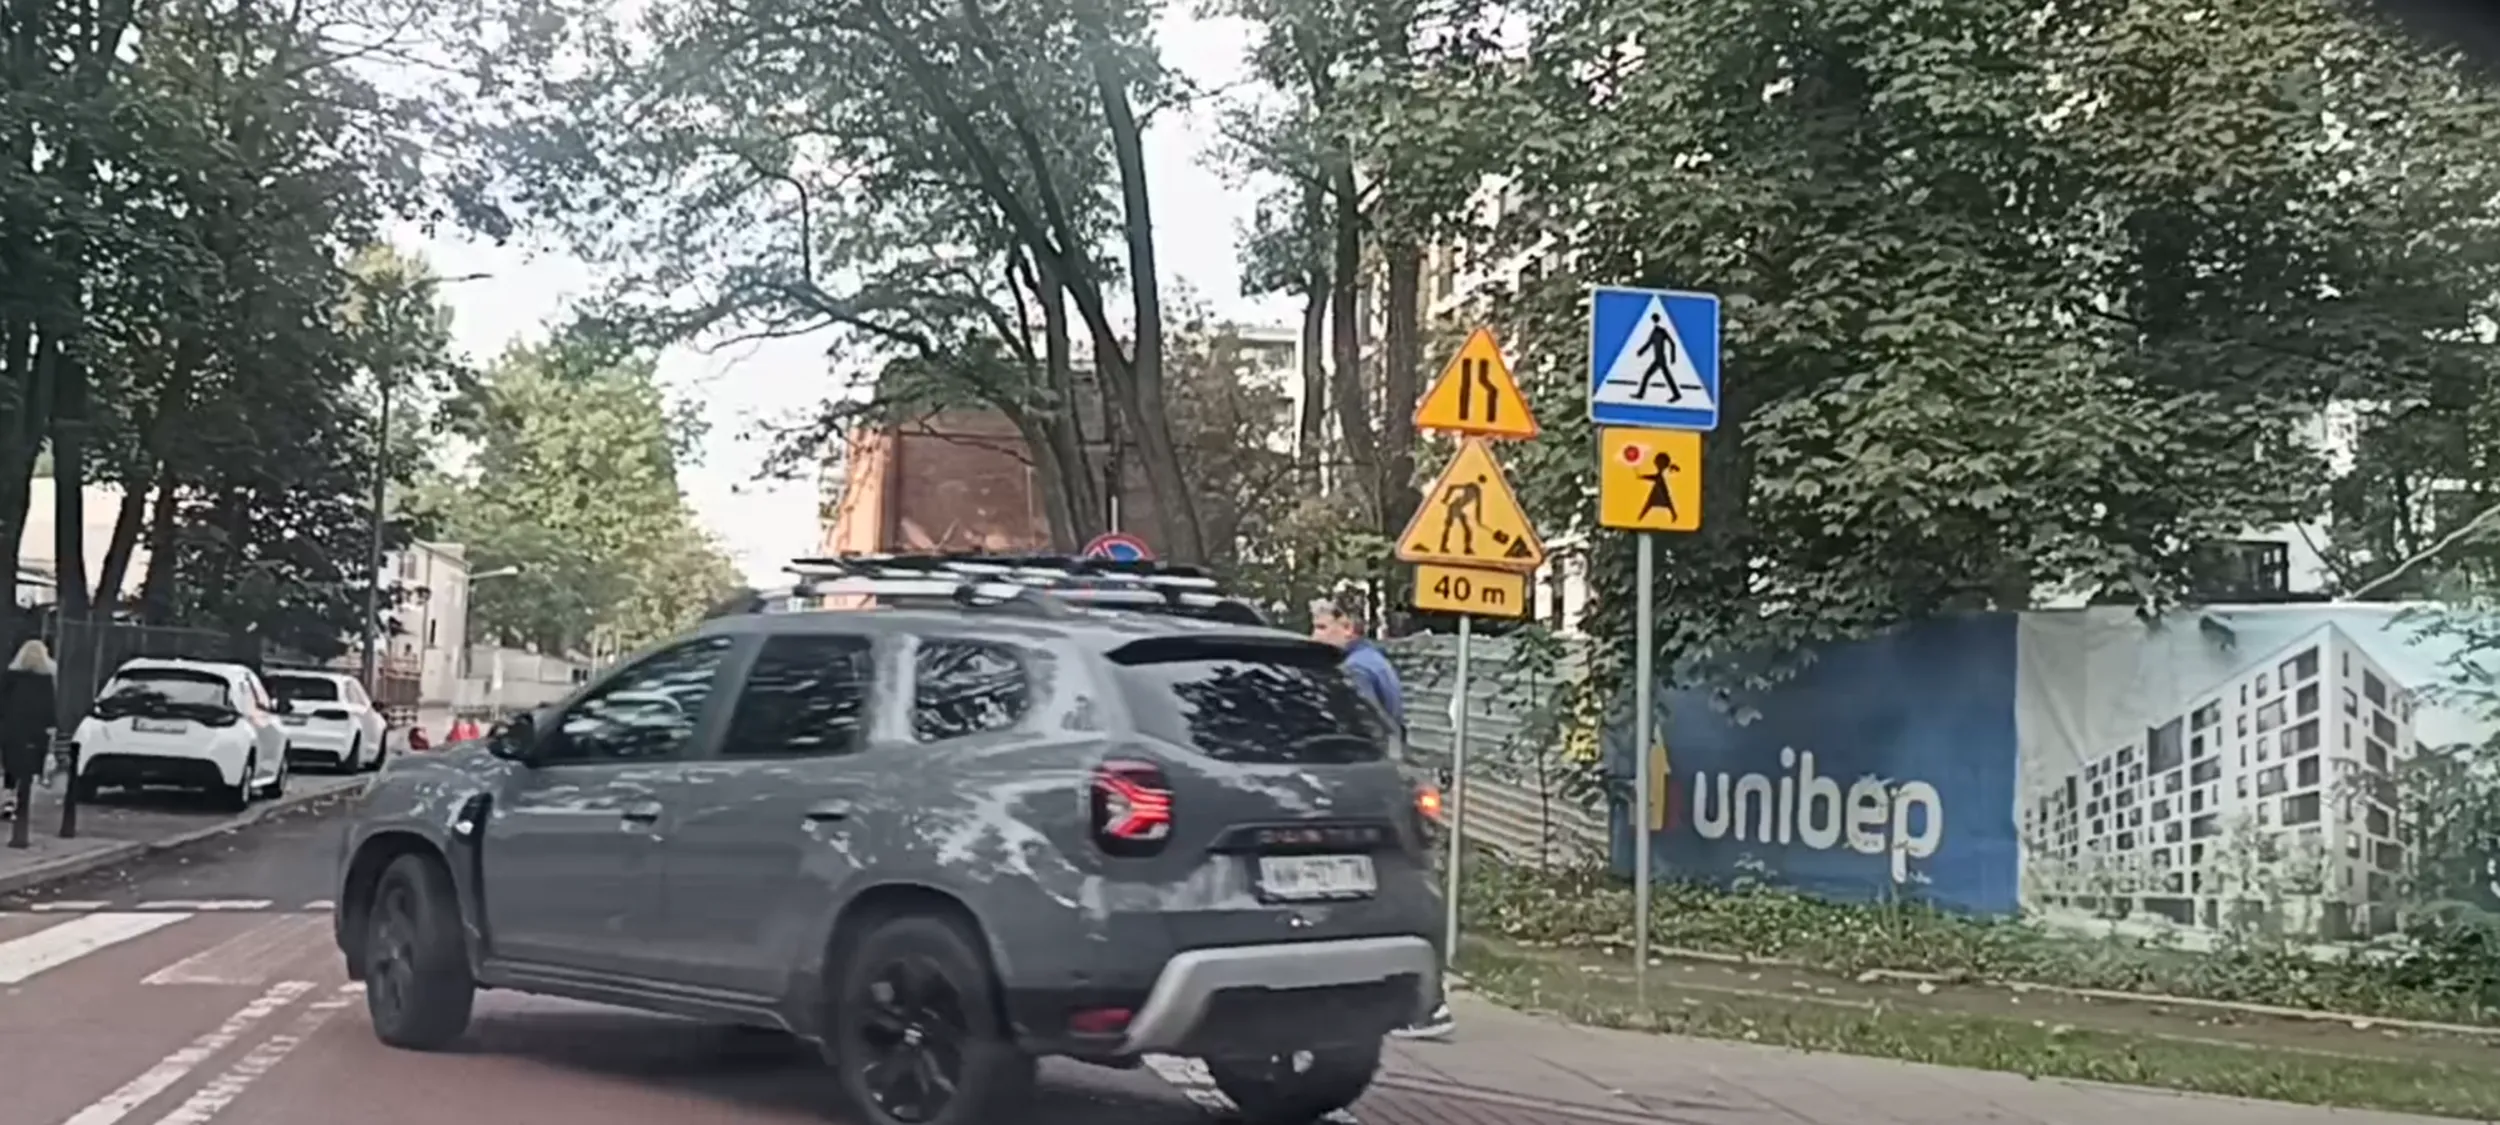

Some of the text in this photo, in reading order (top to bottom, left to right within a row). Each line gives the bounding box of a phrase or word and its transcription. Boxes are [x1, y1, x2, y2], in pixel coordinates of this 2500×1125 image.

[1433, 575, 1505, 605] 40 m
[1693, 746, 1942, 883] unibep
